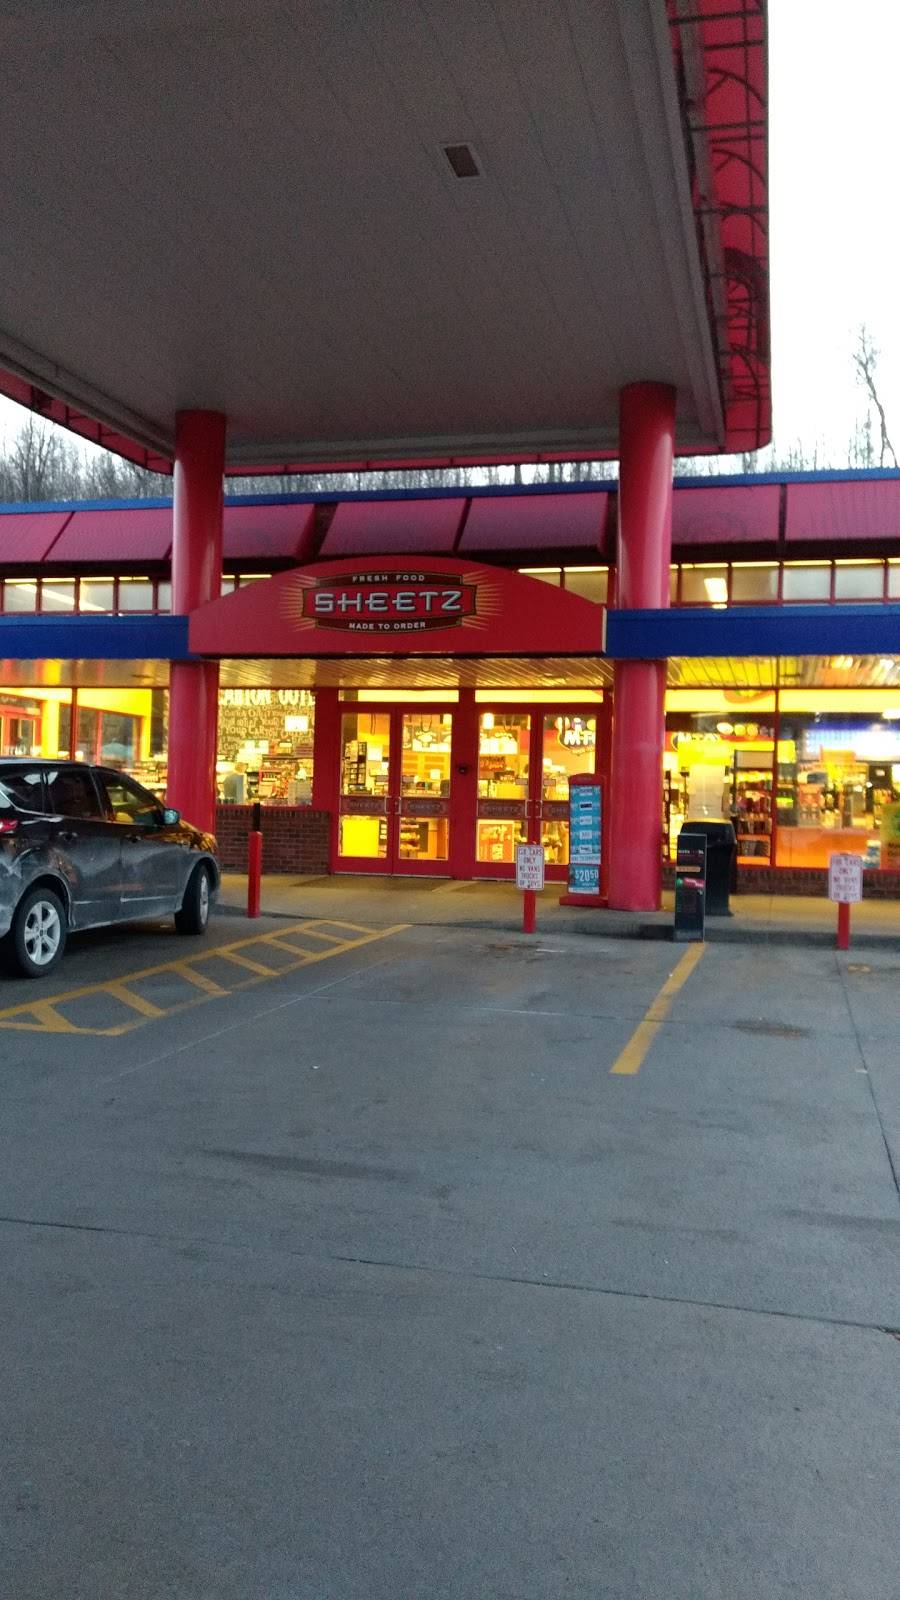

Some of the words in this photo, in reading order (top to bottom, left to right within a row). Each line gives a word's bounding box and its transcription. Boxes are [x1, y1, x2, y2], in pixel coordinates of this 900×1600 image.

[395, 574, 425, 582] FOOD
[314, 590, 463, 612] SHEETZ
[348, 622, 374, 630] MADE
[393, 621, 426, 630] ORDER
